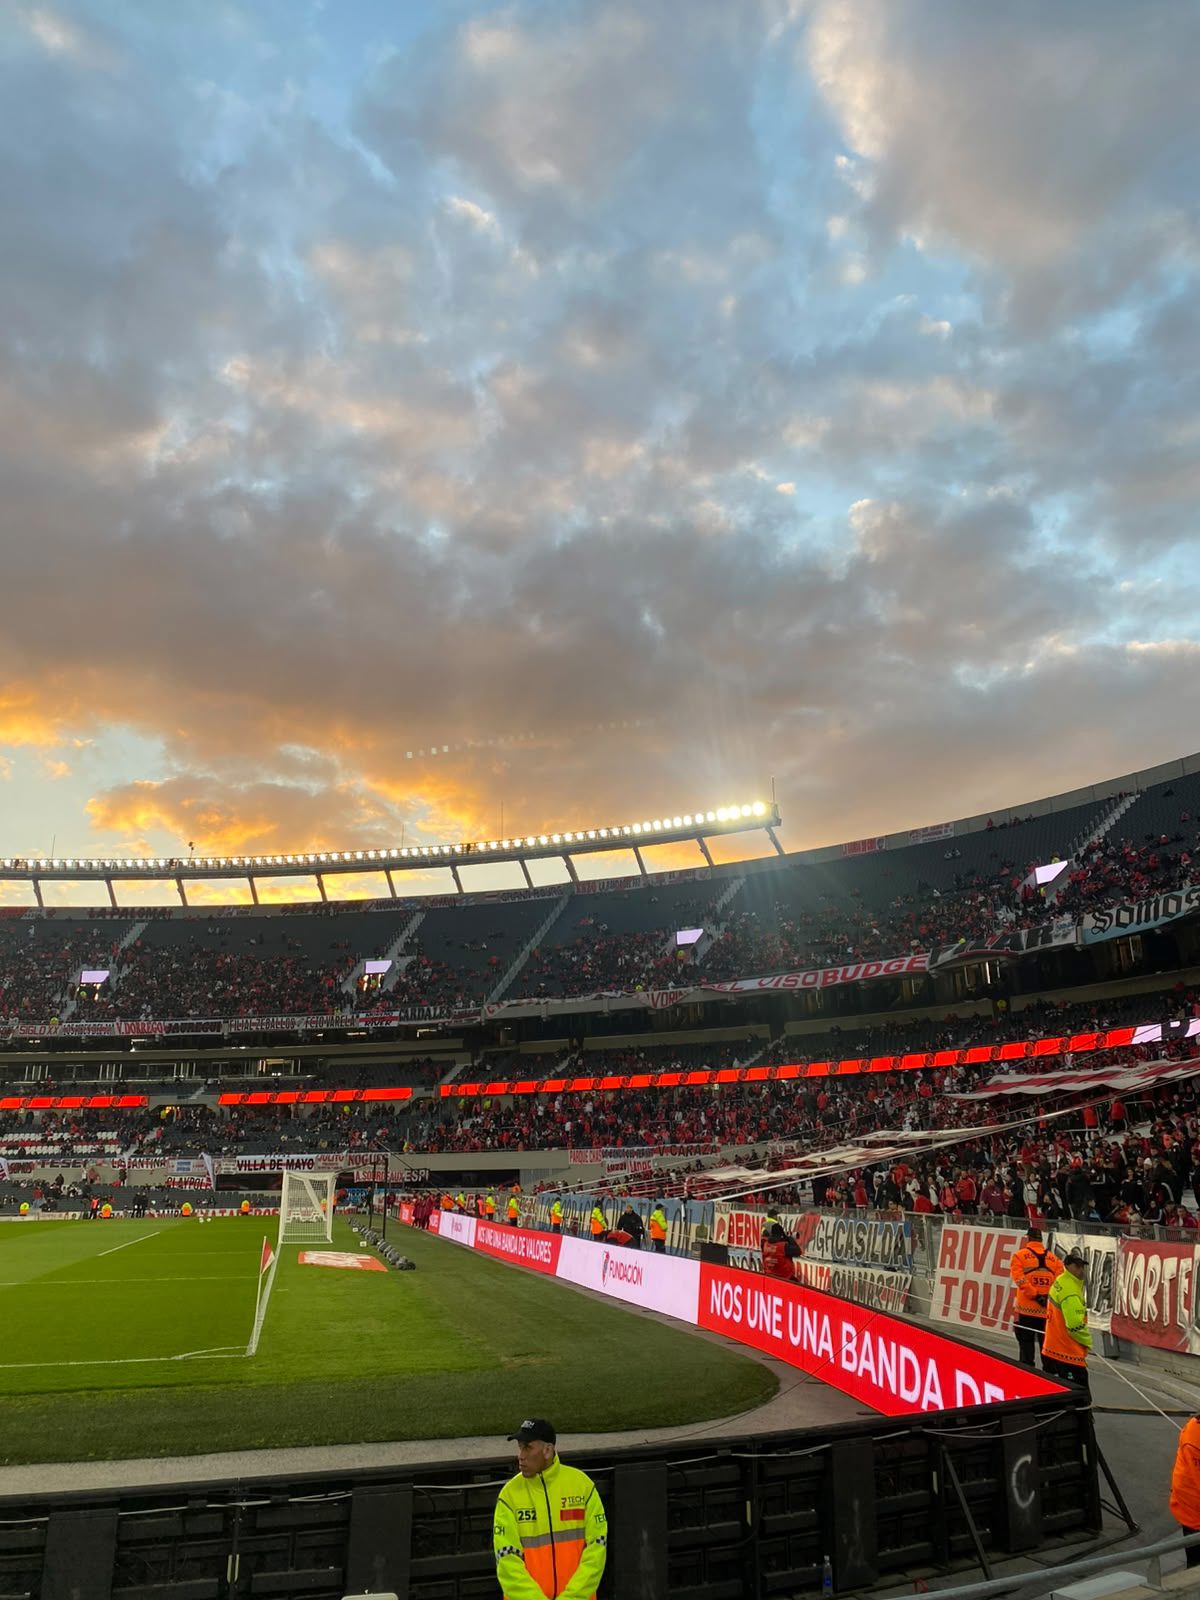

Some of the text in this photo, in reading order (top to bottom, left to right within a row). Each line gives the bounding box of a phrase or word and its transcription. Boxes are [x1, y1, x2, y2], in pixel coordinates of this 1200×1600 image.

[237, 1160, 267, 1171] VILLA
[270, 1159, 284, 1170] DE
[286, 1158, 315, 1170] MAYO
[728, 1213, 766, 1249] BERN
[526, 1237, 551, 1264] VALORES
[940, 1229, 1027, 1277] RIVE
[609, 1259, 644, 1286] FUNDACIÓN
[1033, 1277, 1050, 1286] 352
[1114, 1251, 1193, 1328] NORTE
[710, 1279, 743, 1323] NOS
[746, 1289, 783, 1340] UNE
[788, 1304, 835, 1364] UNA
[841, 1320, 944, 1411] BANDA
[517, 1510, 537, 1521] 252
